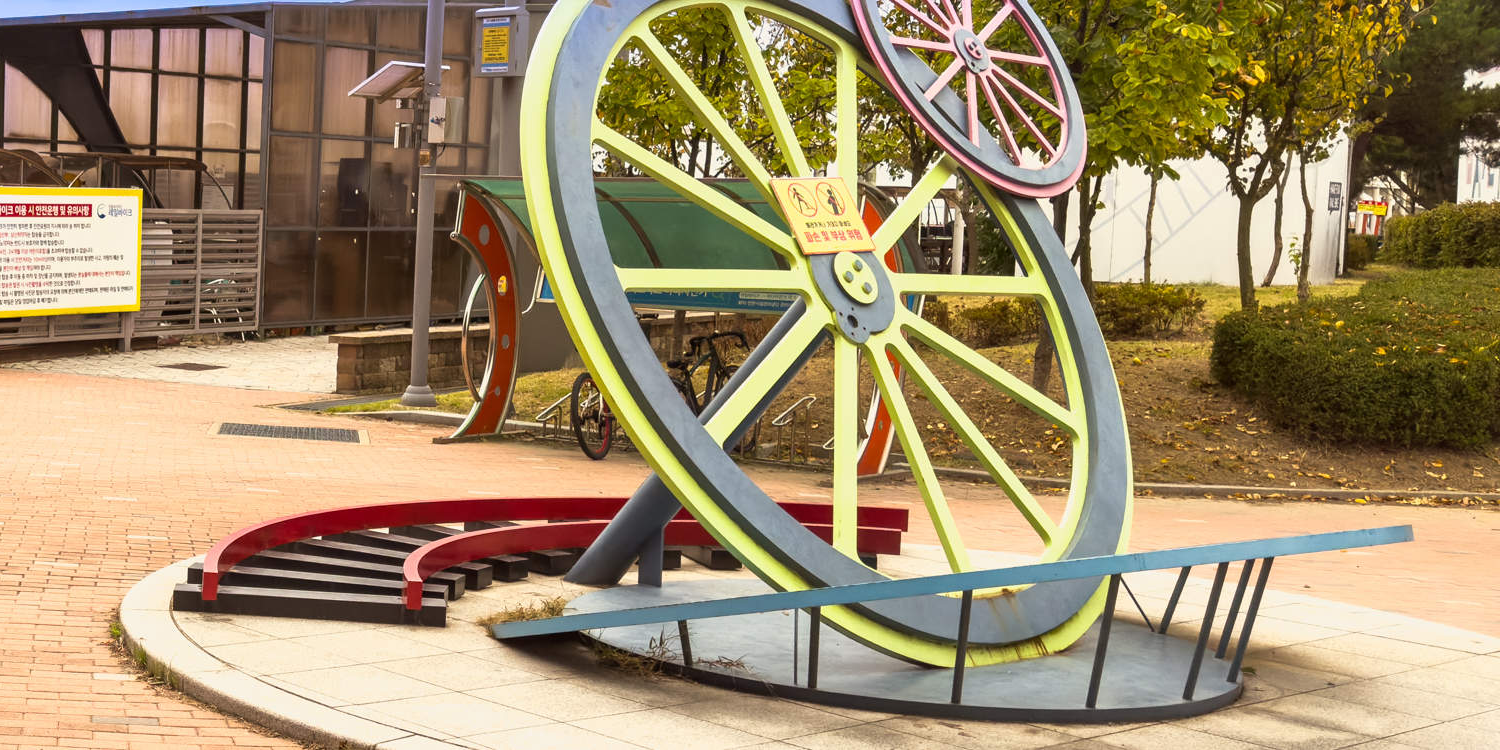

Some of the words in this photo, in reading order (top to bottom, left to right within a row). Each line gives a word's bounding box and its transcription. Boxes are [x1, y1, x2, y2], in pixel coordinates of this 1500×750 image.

[15, 205, 27, 216] 이용
[28, 205, 35, 216] 시
[35, 205, 59, 216] 안전운행
[67, 205, 89, 217] 유의사항
